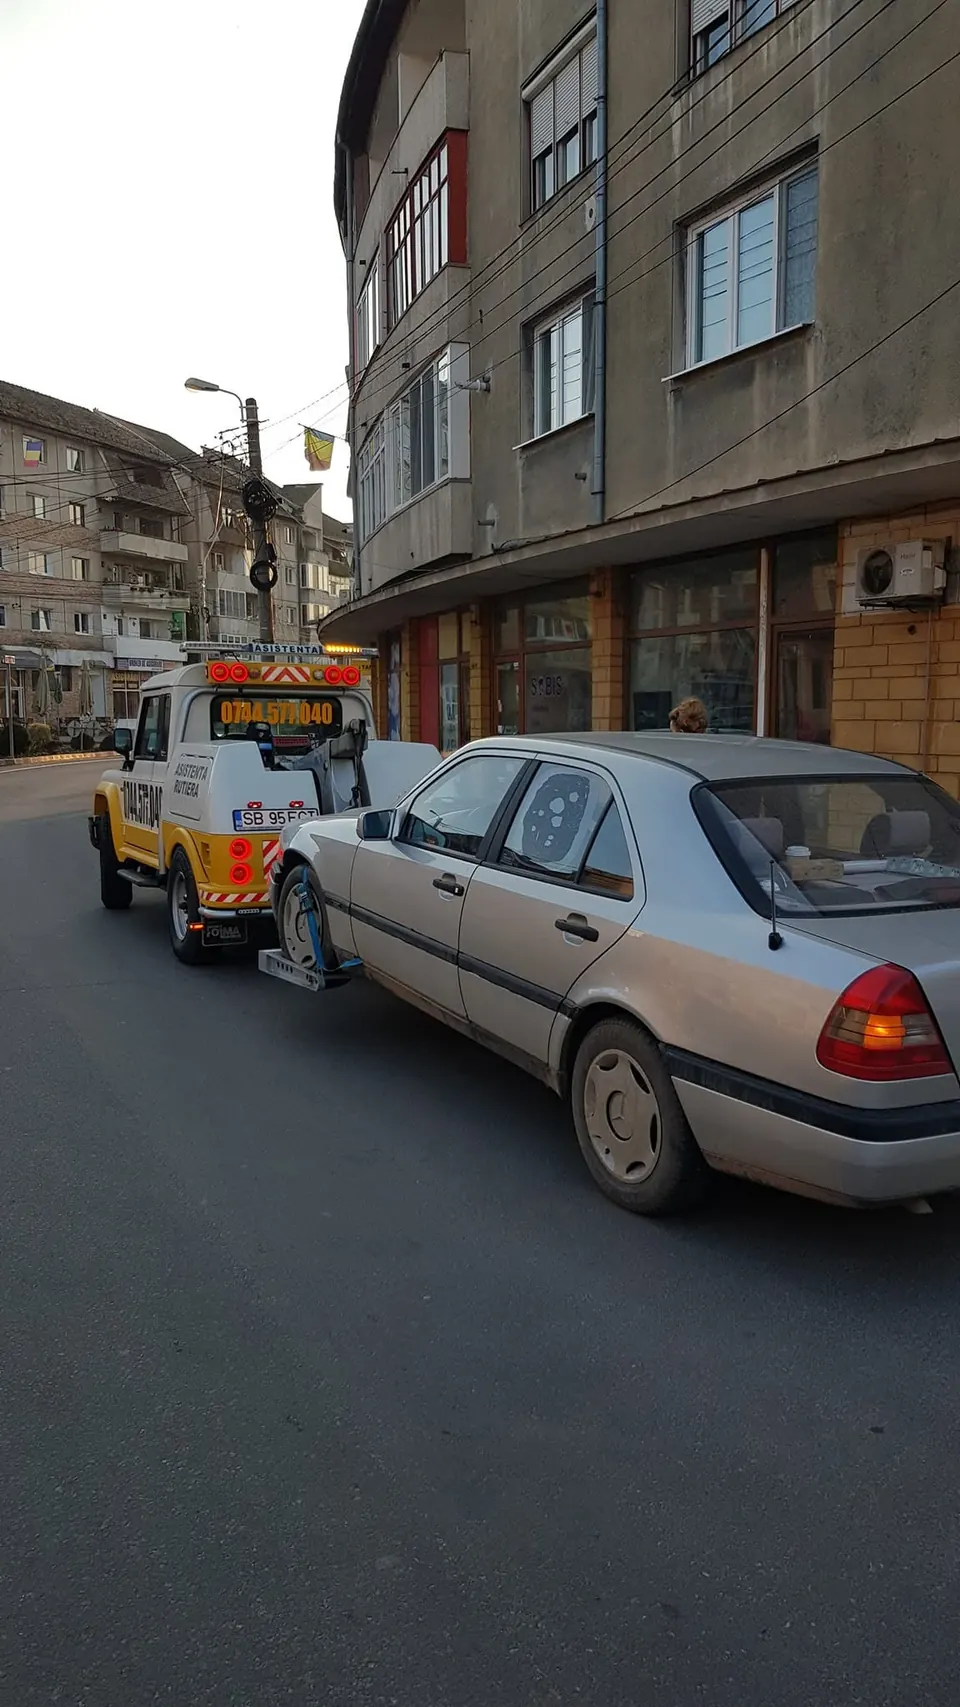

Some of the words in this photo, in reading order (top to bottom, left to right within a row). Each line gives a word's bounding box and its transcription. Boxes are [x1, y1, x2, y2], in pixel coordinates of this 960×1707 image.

[255, 643, 318, 654] ASISTENTA
[221, 700, 333, 726] 0744.577.040
[174, 763, 209, 781] ASISTENTA
[173, 779, 200, 798] RUTIERA
[243, 811, 263, 825] SB
